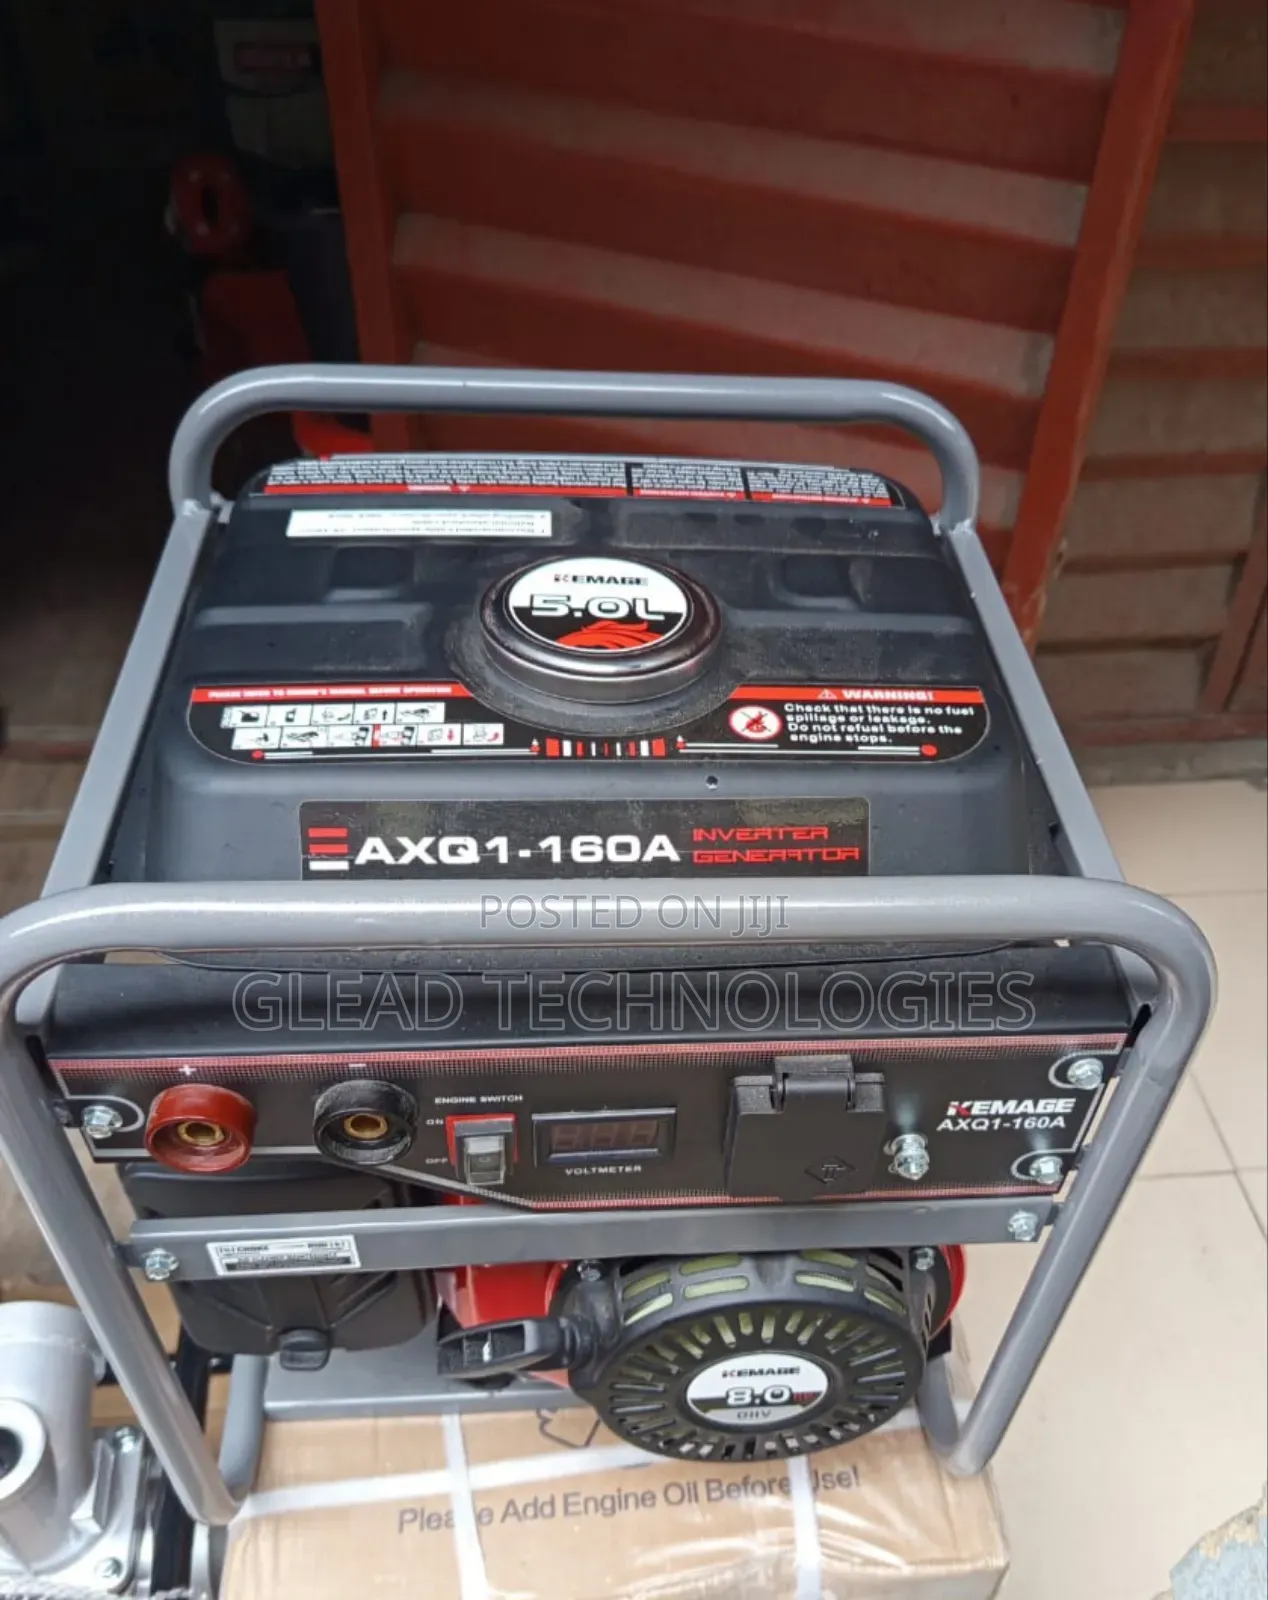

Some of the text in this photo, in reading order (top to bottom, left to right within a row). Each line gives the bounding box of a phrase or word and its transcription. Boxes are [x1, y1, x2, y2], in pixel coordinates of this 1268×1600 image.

[554, 574, 648, 586] KEMAGE
[841, 689, 935, 701] WARNING!
[784, 703, 975, 717] Check that there is no fuel
[786, 713, 931, 726] spillage or leakage.
[788, 722, 963, 736] Do not refuel before the
[790, 732, 893, 744] engine stops.
[692, 826, 830, 843] INVERTER
[354, 834, 682, 866] AXQ1-160A
[692, 847, 860, 864] GENERATOR
[434, 1093, 523, 1104] ENGINE SWITCH
[946, 1097, 1077, 1117] KEMAGE
[426, 1118, 444, 1126] ON
[936, 1116, 1067, 1132] AXQ1-160A
[425, 1156, 448, 1165] OFF
[565, 1164, 642, 1176] VOLTMETER
[722, 1366, 801, 1379] KEMAGE
[726, 1384, 793, 1407] 8.0
[736, 1409, 772, 1420] OHV
[398, 1506, 494, 1534] Pleae
[500, 1494, 556, 1523] Add
[563, 1487, 657, 1517] Engine
[663, 1480, 699, 1507] Oil
[705, 1474, 791, 1503] Before
